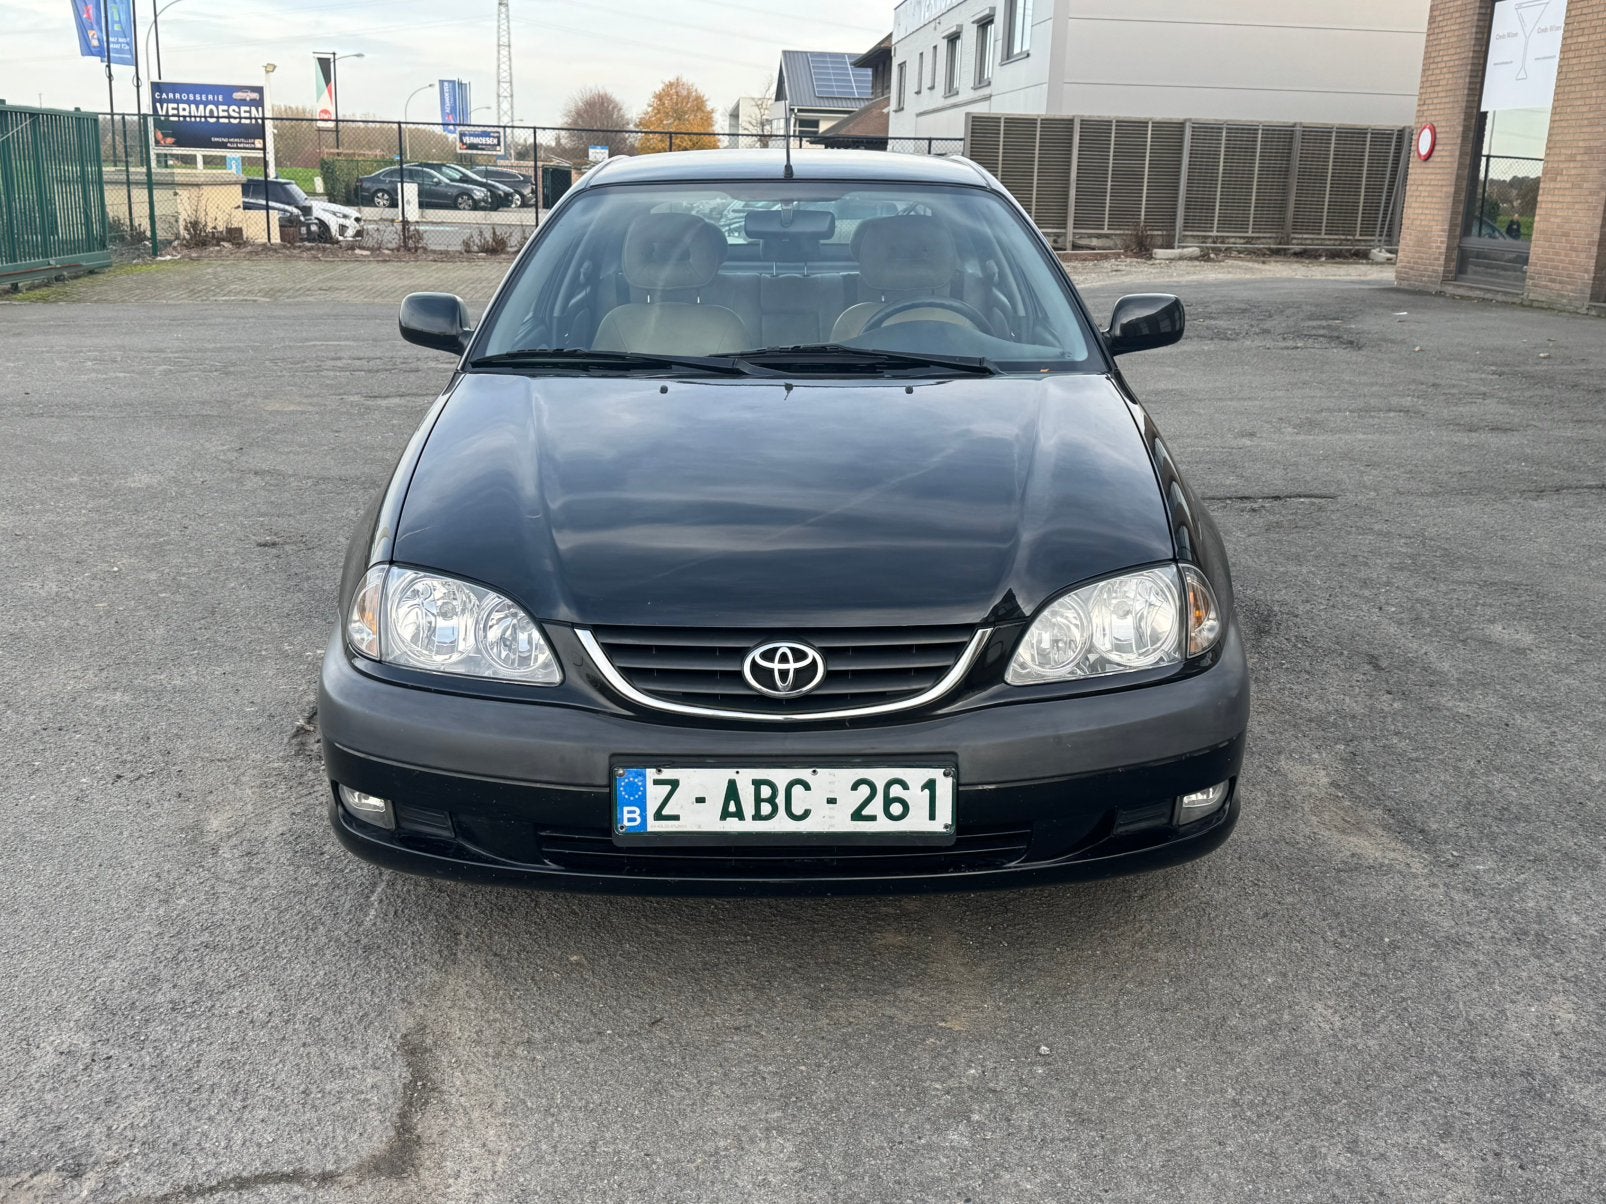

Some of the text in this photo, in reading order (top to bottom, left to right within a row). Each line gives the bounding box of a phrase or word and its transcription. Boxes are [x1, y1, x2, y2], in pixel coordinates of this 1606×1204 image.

[155, 92, 224, 102] CARROSSERIE
[155, 103, 263, 124] VERMOESEN
[462, 136, 498, 145] VERMOESEN
[652, 777, 937, 822] Z-ABC-261
[623, 806, 641, 827] B
